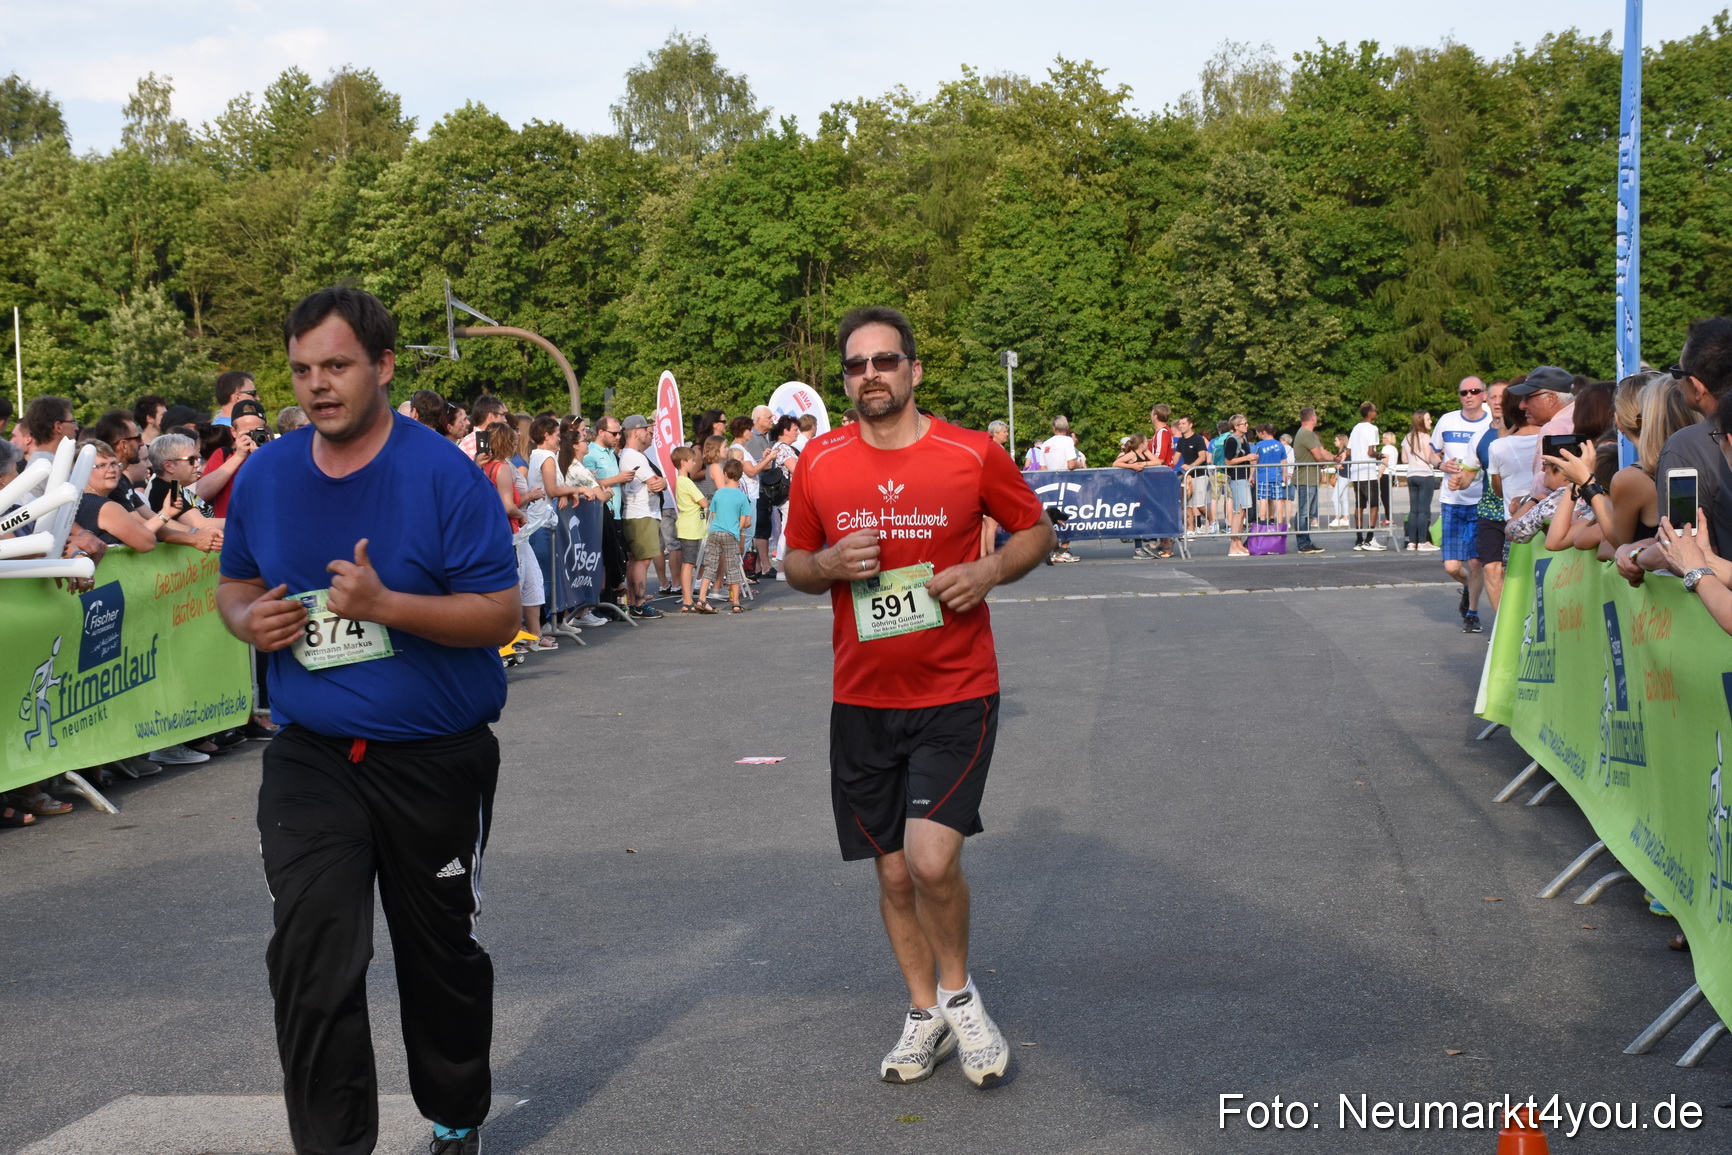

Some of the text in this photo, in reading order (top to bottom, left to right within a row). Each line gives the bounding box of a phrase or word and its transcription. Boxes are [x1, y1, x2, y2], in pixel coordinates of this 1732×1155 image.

[836, 507, 949, 531] Echtes Handwerk
[1053, 520, 1133, 531] AUTOMOBILE
[891, 529, 932, 539] FRISCH
[173, 592, 204, 627] laufen
[872, 591, 916, 620] 591
[90, 609, 119, 630] Fischer
[871, 613, 925, 629] Göhring Günther
[305, 616, 365, 648] 874
[304, 640, 373, 658] Wittmann Markus
[313, 655, 326, 663] Fritz
[327, 652, 345, 660] Berger
[58, 633, 158, 719] firmenlauf
[62, 705, 107, 739] neumarkt
